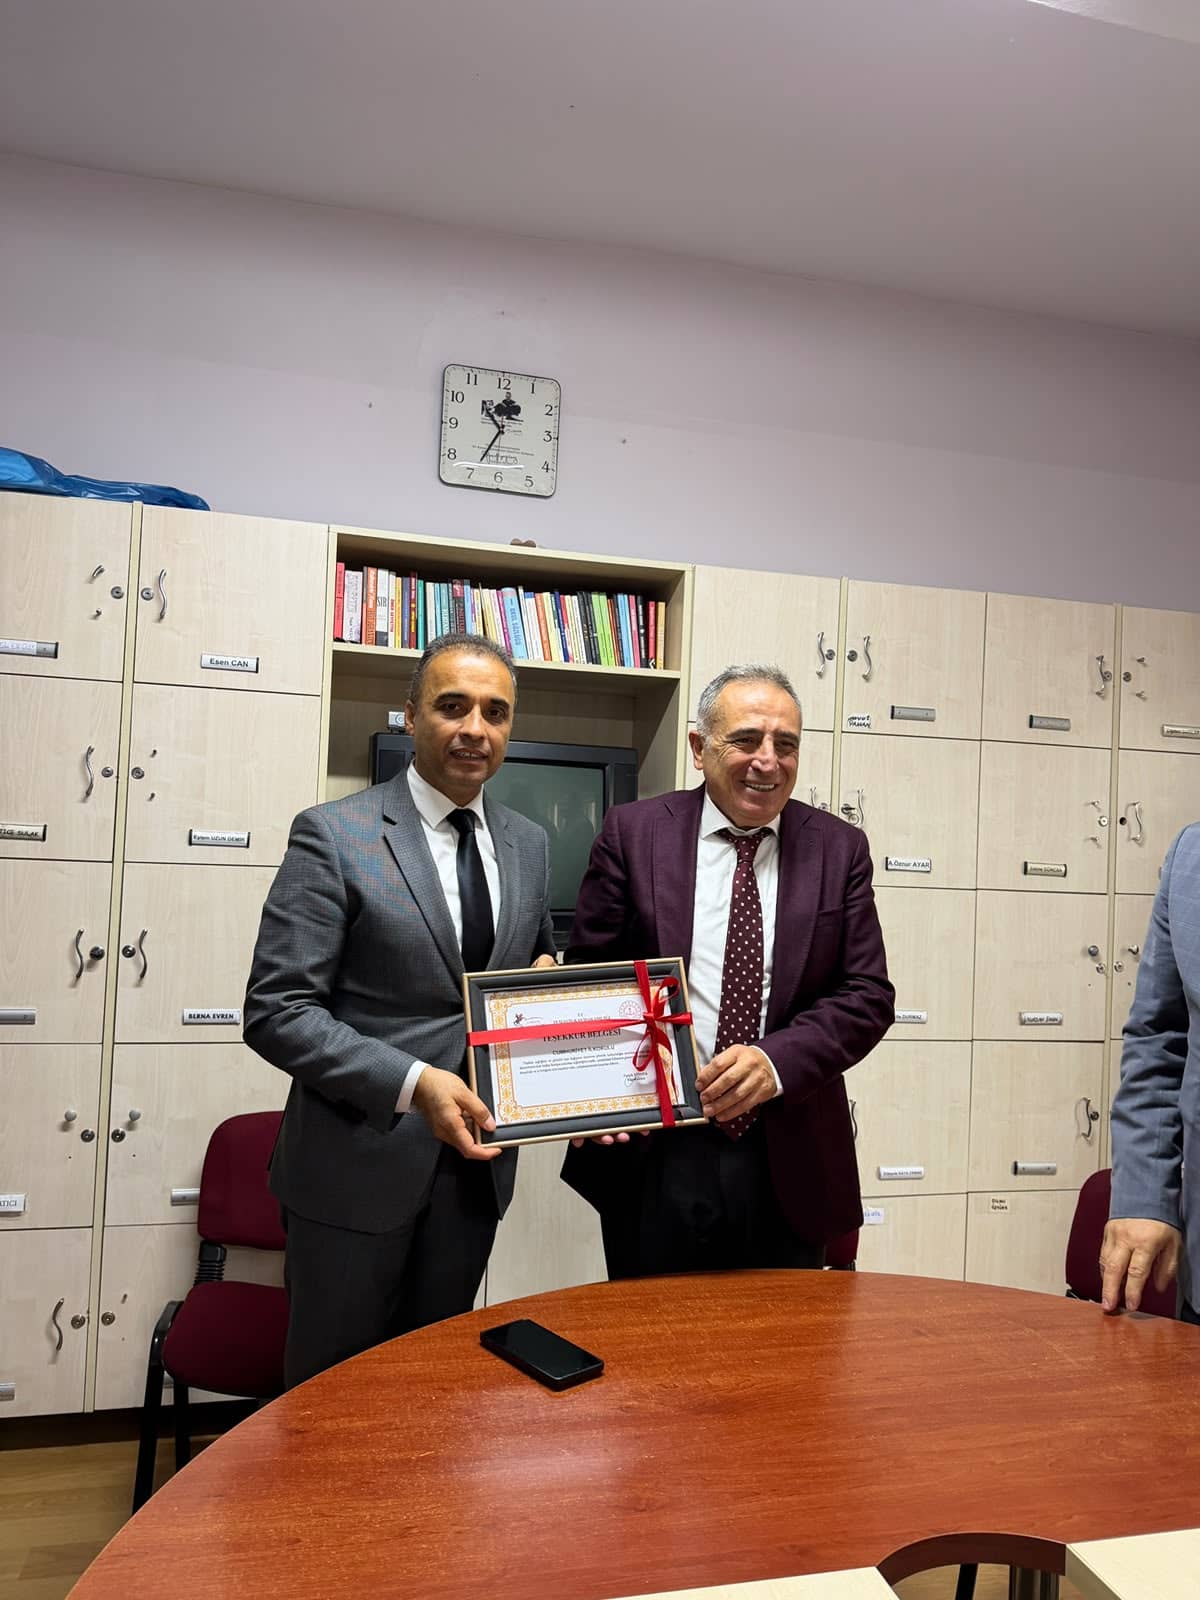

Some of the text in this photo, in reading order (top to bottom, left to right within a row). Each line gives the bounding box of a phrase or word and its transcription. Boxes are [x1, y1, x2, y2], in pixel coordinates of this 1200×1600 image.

[466, 373, 478, 385] 11
[497, 378, 511, 390] 12
[530, 382, 536, 394] 1
[450, 390, 465, 403] 10
[544, 404, 553, 416] 2
[448, 417, 459, 429] 9
[543, 430, 553, 442] 3
[447, 448, 457, 460] 8
[466, 467, 475, 479] 7
[541, 461, 550, 473] 4
[494, 471, 503, 483] 6
[524, 476, 534, 487] 5
[209, 657, 249, 668] Esen CAN
